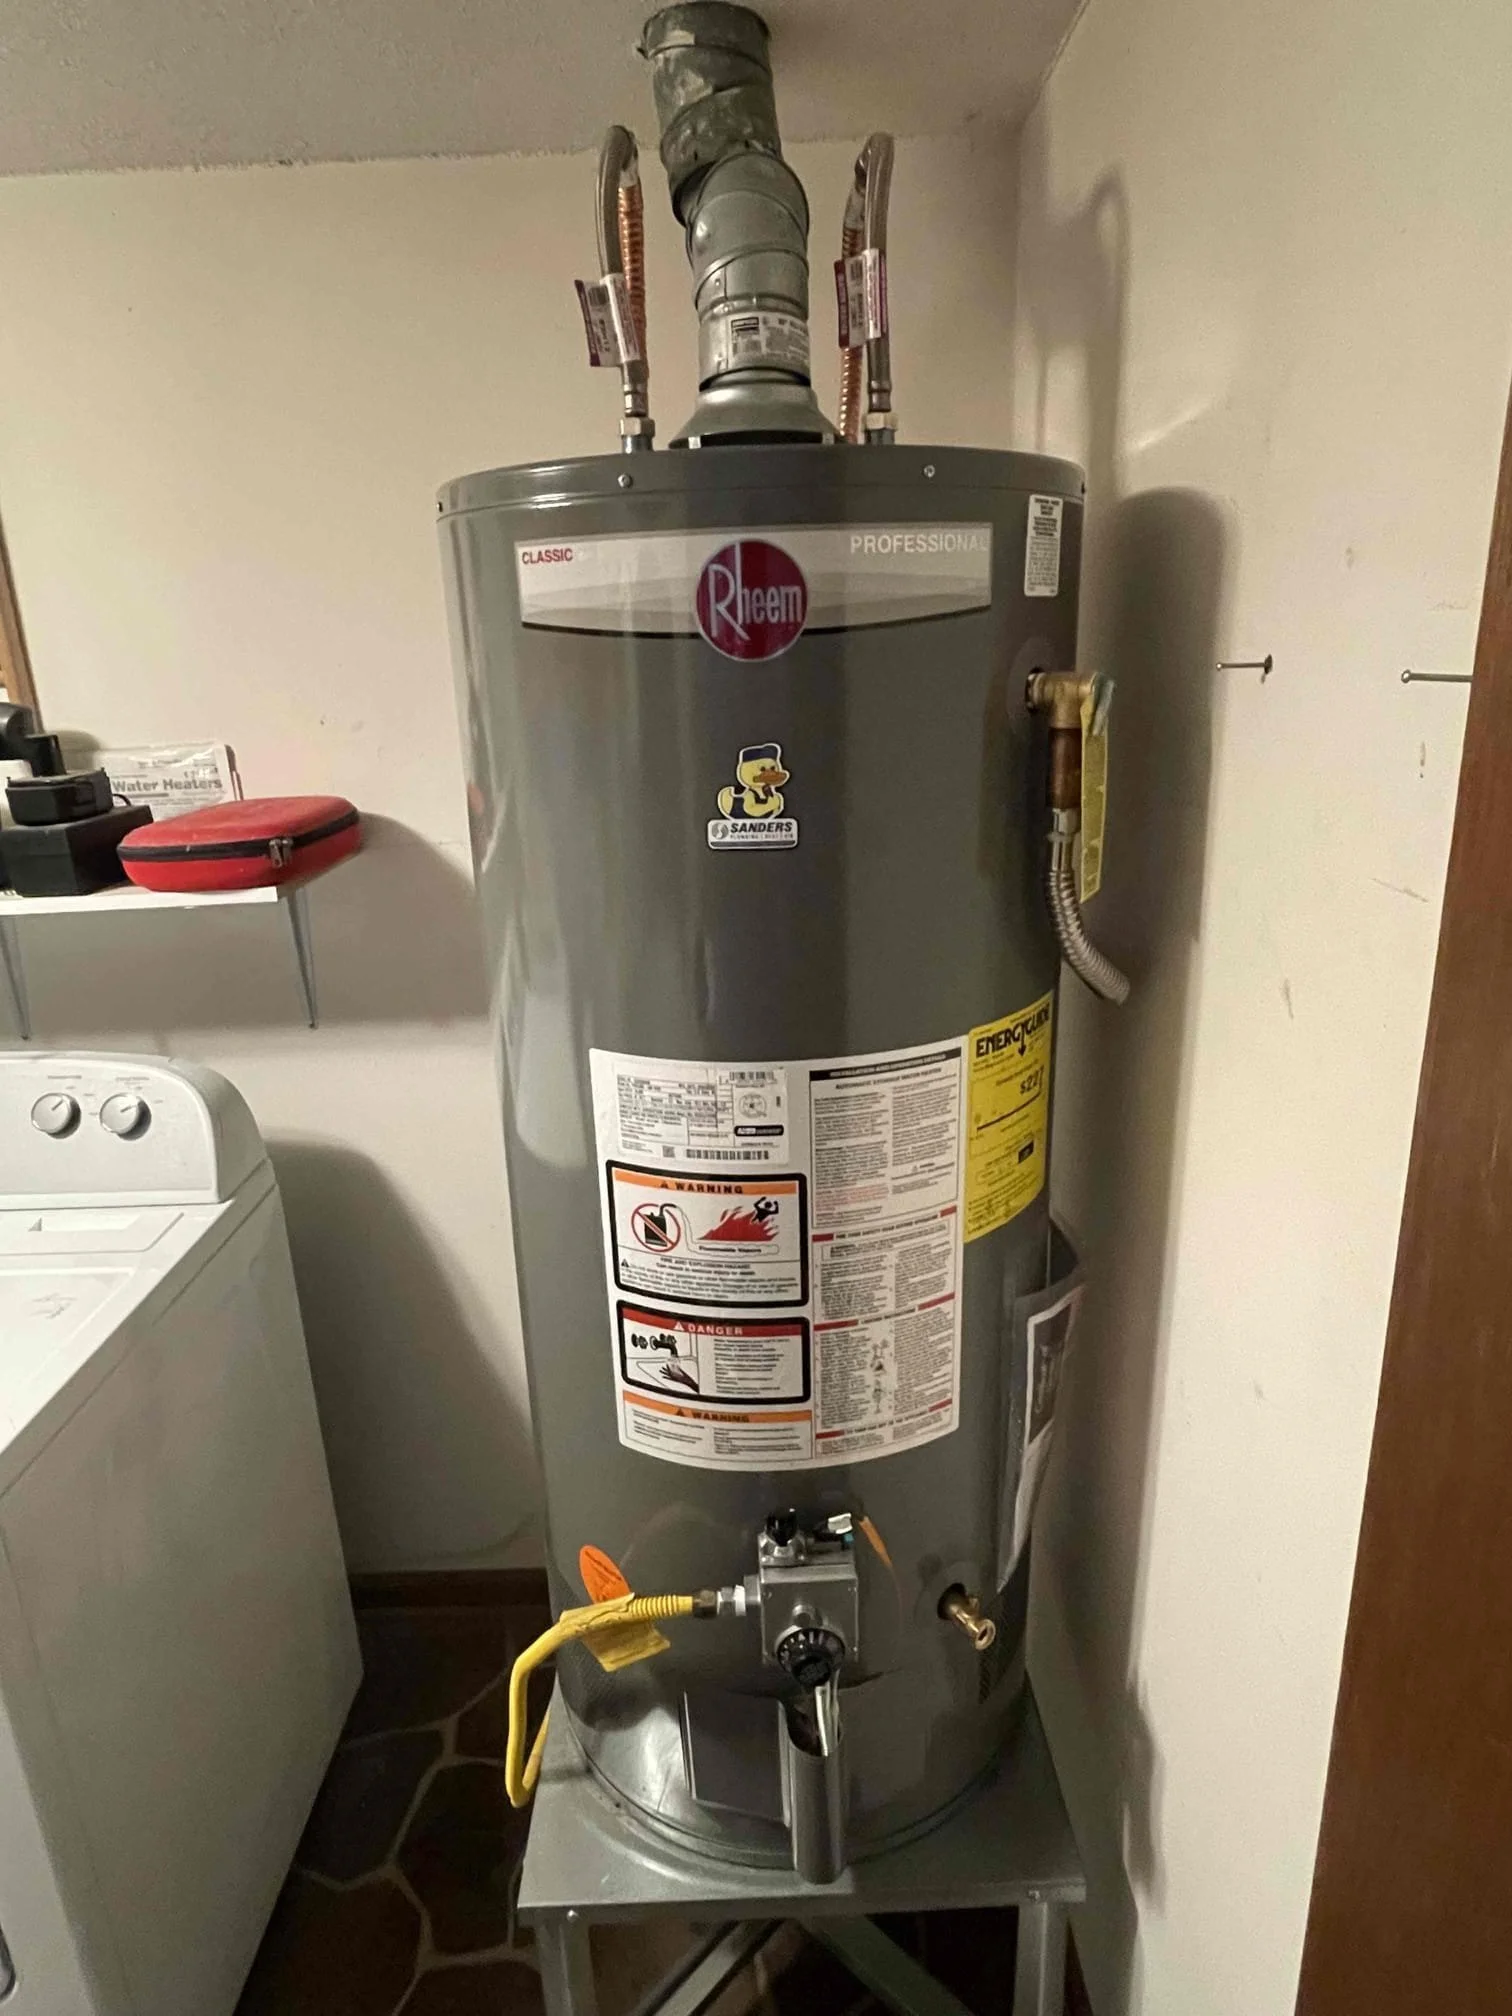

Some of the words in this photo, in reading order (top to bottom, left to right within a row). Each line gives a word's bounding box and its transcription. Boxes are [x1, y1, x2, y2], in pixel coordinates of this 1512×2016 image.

[850, 534, 989, 554] PROFESSIONAL
[522, 548, 573, 564] CLASSIC
[707, 541, 802, 640] Rheem
[112, 780, 158, 792] Water
[162, 778, 222, 790] Heaters
[730, 822, 793, 833] SANDERS
[674, 1182, 744, 1194] WARNING
[688, 1325, 743, 1335] DANGER
[693, 1410, 750, 1423] WARNING
